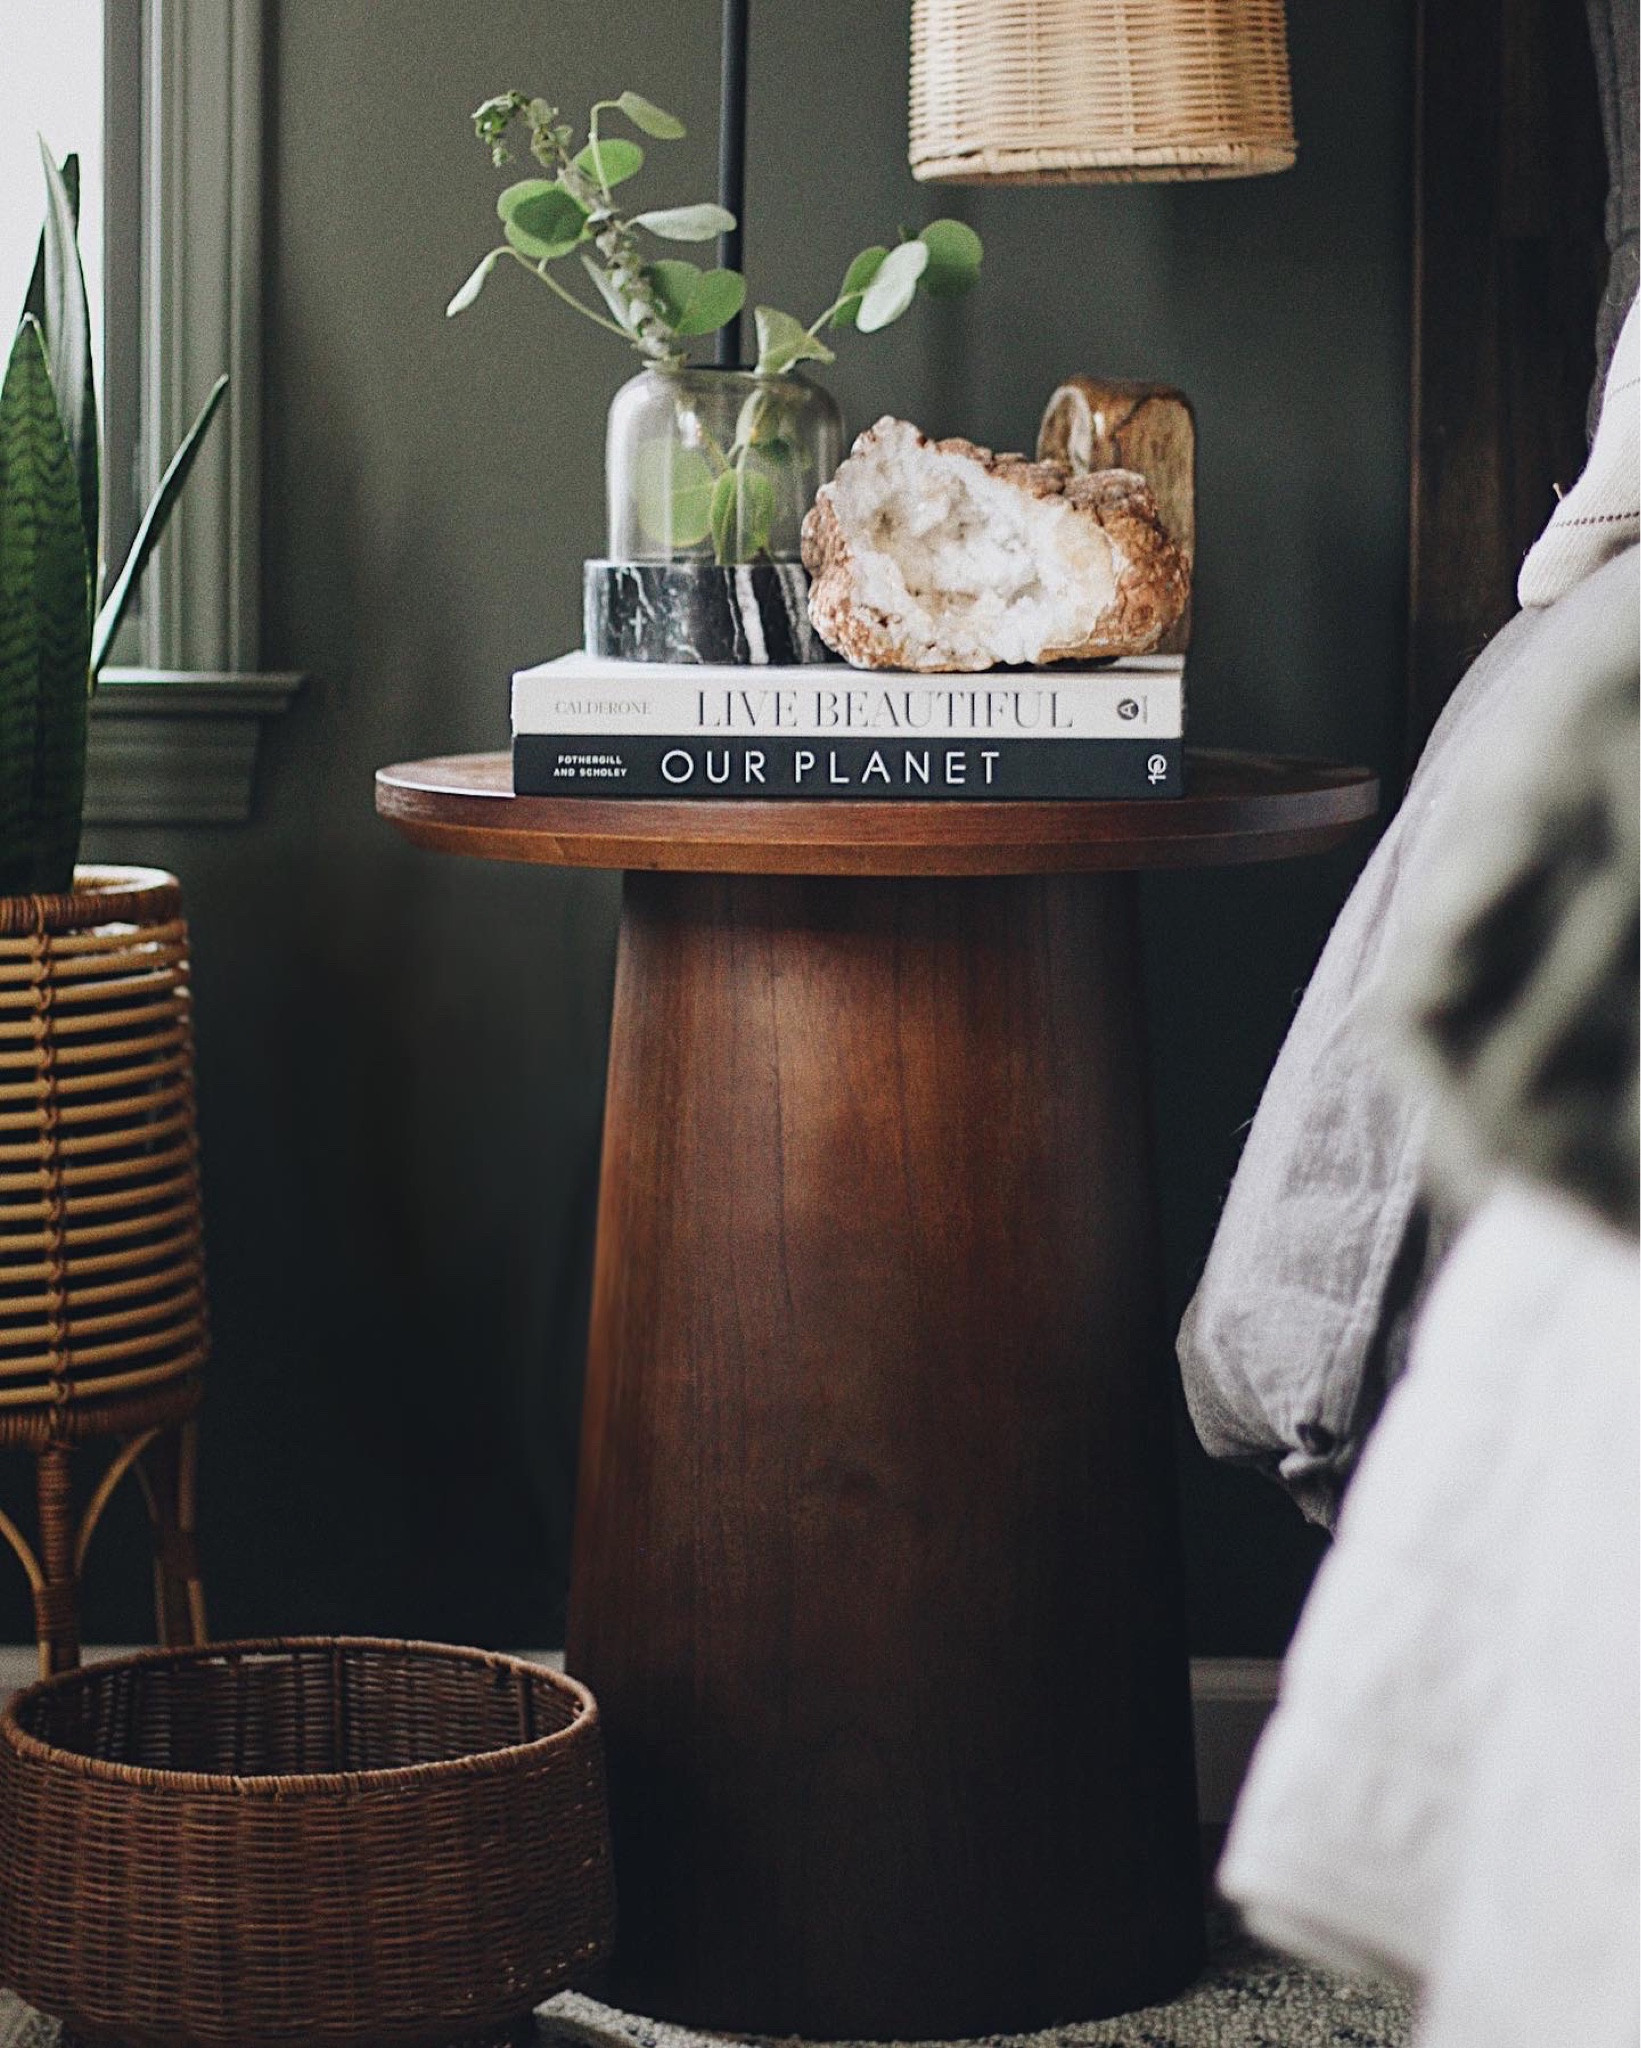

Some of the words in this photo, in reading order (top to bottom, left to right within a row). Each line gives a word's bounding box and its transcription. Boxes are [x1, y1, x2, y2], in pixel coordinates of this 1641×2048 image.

[554, 701, 652, 715] CALDERONE
[698, 690, 798, 728] LIVE
[815, 690, 1074, 728] BEAUTIFUL
[557, 755, 622, 766] FOTHERGILL
[661, 749, 766, 784] OUR
[795, 750, 1000, 784] PLANET
[553, 768, 575, 778] AND
[579, 768, 628, 778] SCHOLEY
